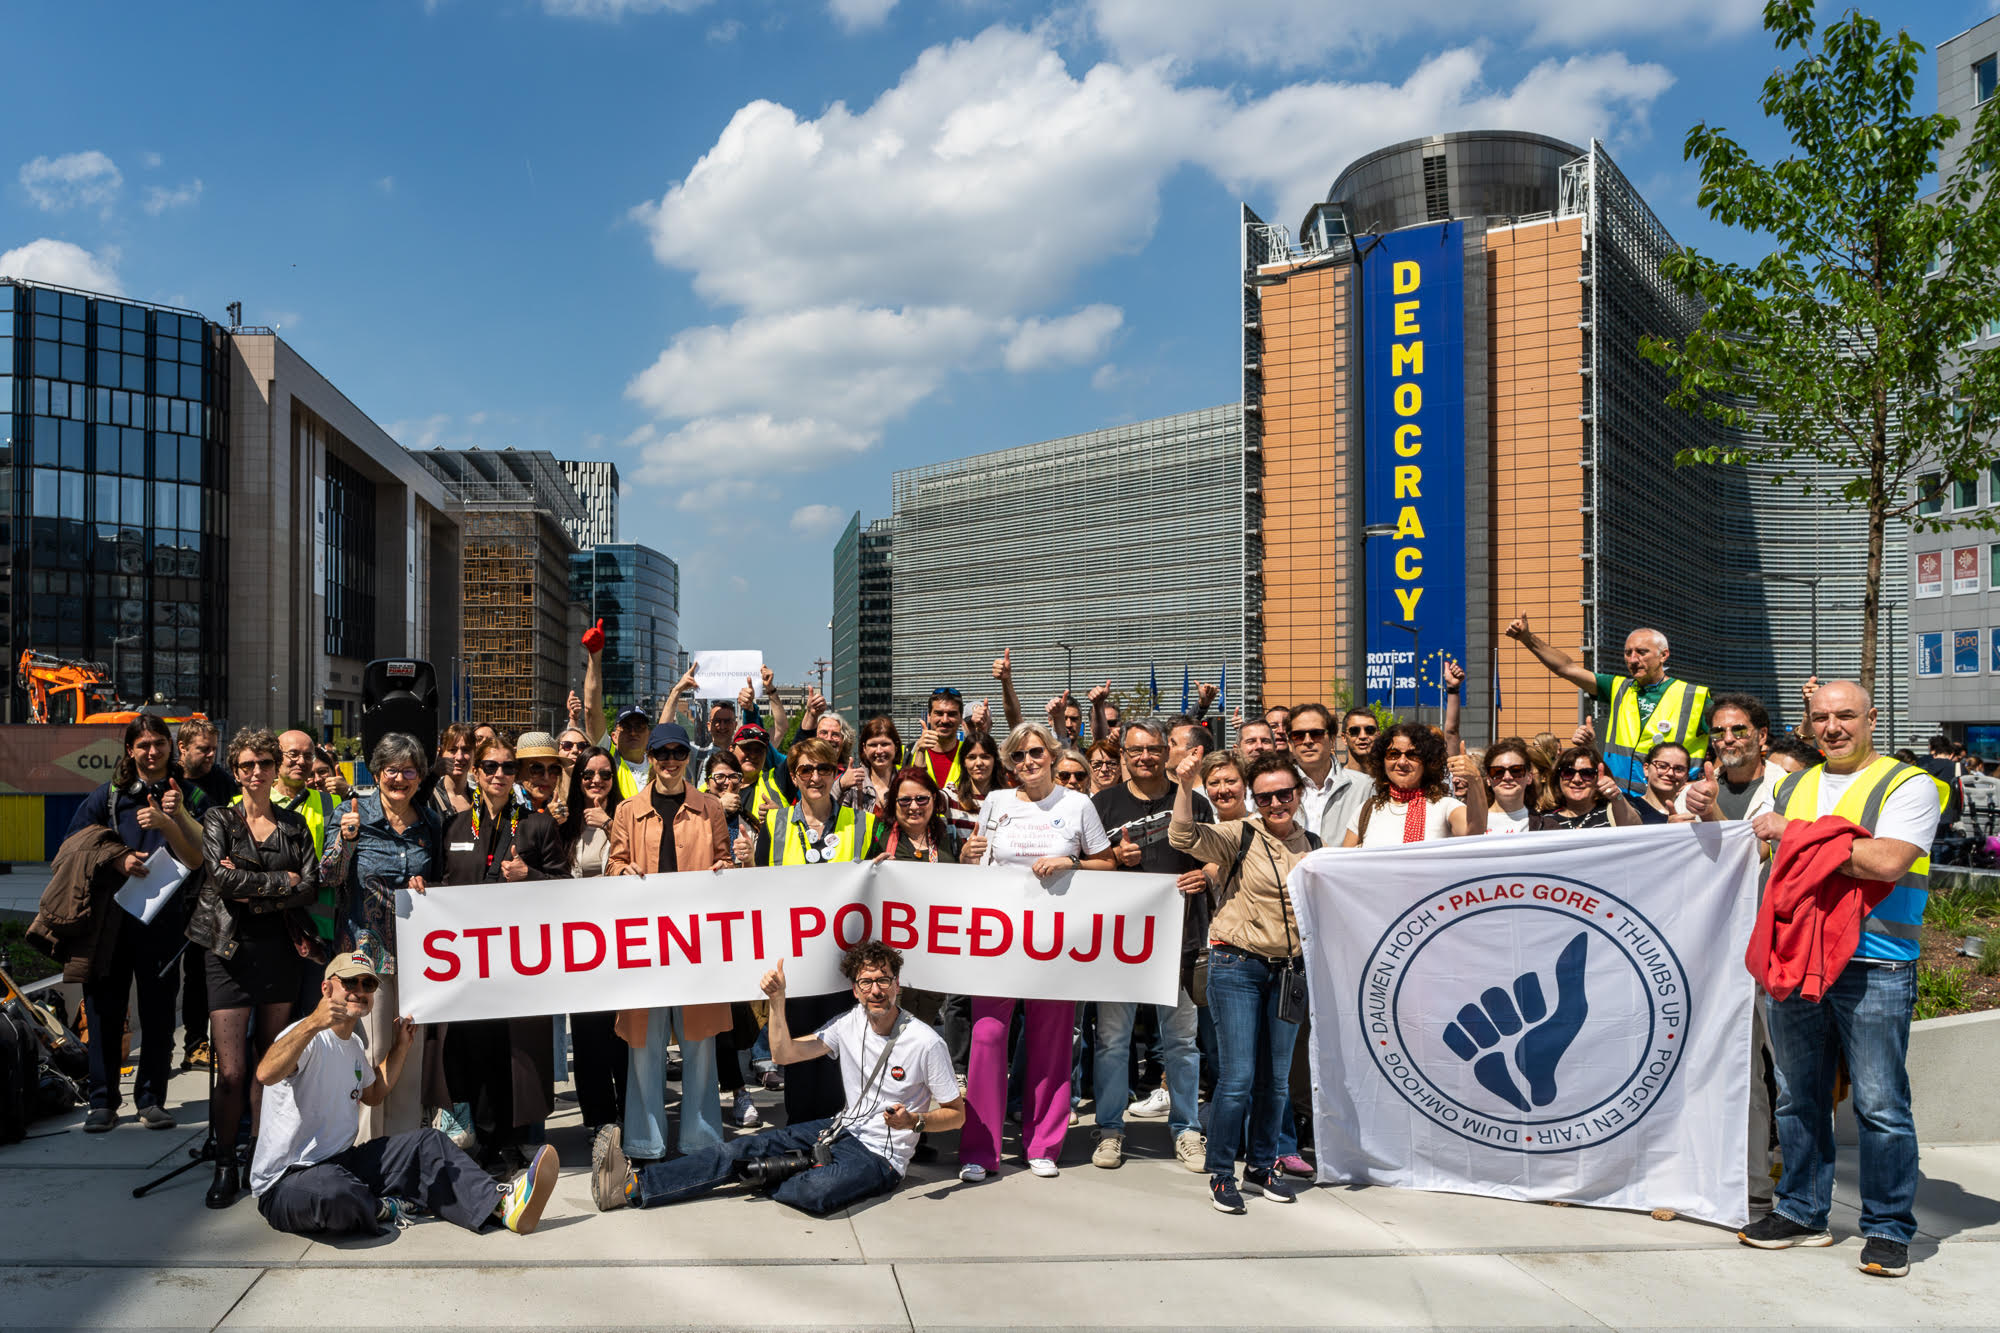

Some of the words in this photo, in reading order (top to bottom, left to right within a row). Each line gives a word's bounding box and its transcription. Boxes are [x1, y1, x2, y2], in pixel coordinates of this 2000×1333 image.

[1392, 260, 1425, 621] DEMOCRACY
[1955, 635, 1978, 648] EXPO
[1366, 652, 1415, 664] ROTECT
[1366, 677, 1420, 689] ATTERS.
[1449, 883, 1525, 911] PALAC
[1532, 884, 1600, 915] GORE
[423, 909, 765, 982] STUDENTI
[789, 901, 1156, 965] POBEĐUJU
[1369, 961, 1396, 1034] DAUMEN
[1386, 909, 1437, 960] HOCH
[1616, 917, 1677, 997] THUMBS
[1661, 1002, 1680, 1028] UP
[1385, 1053, 1459, 1122] OMHOOG
[1621, 1049, 1673, 1113] POUCE
[1463, 1117, 1518, 1144] DUIM
[1537, 1122, 1592, 1144] L'AIR
[1593, 1108, 1625, 1132] EN
